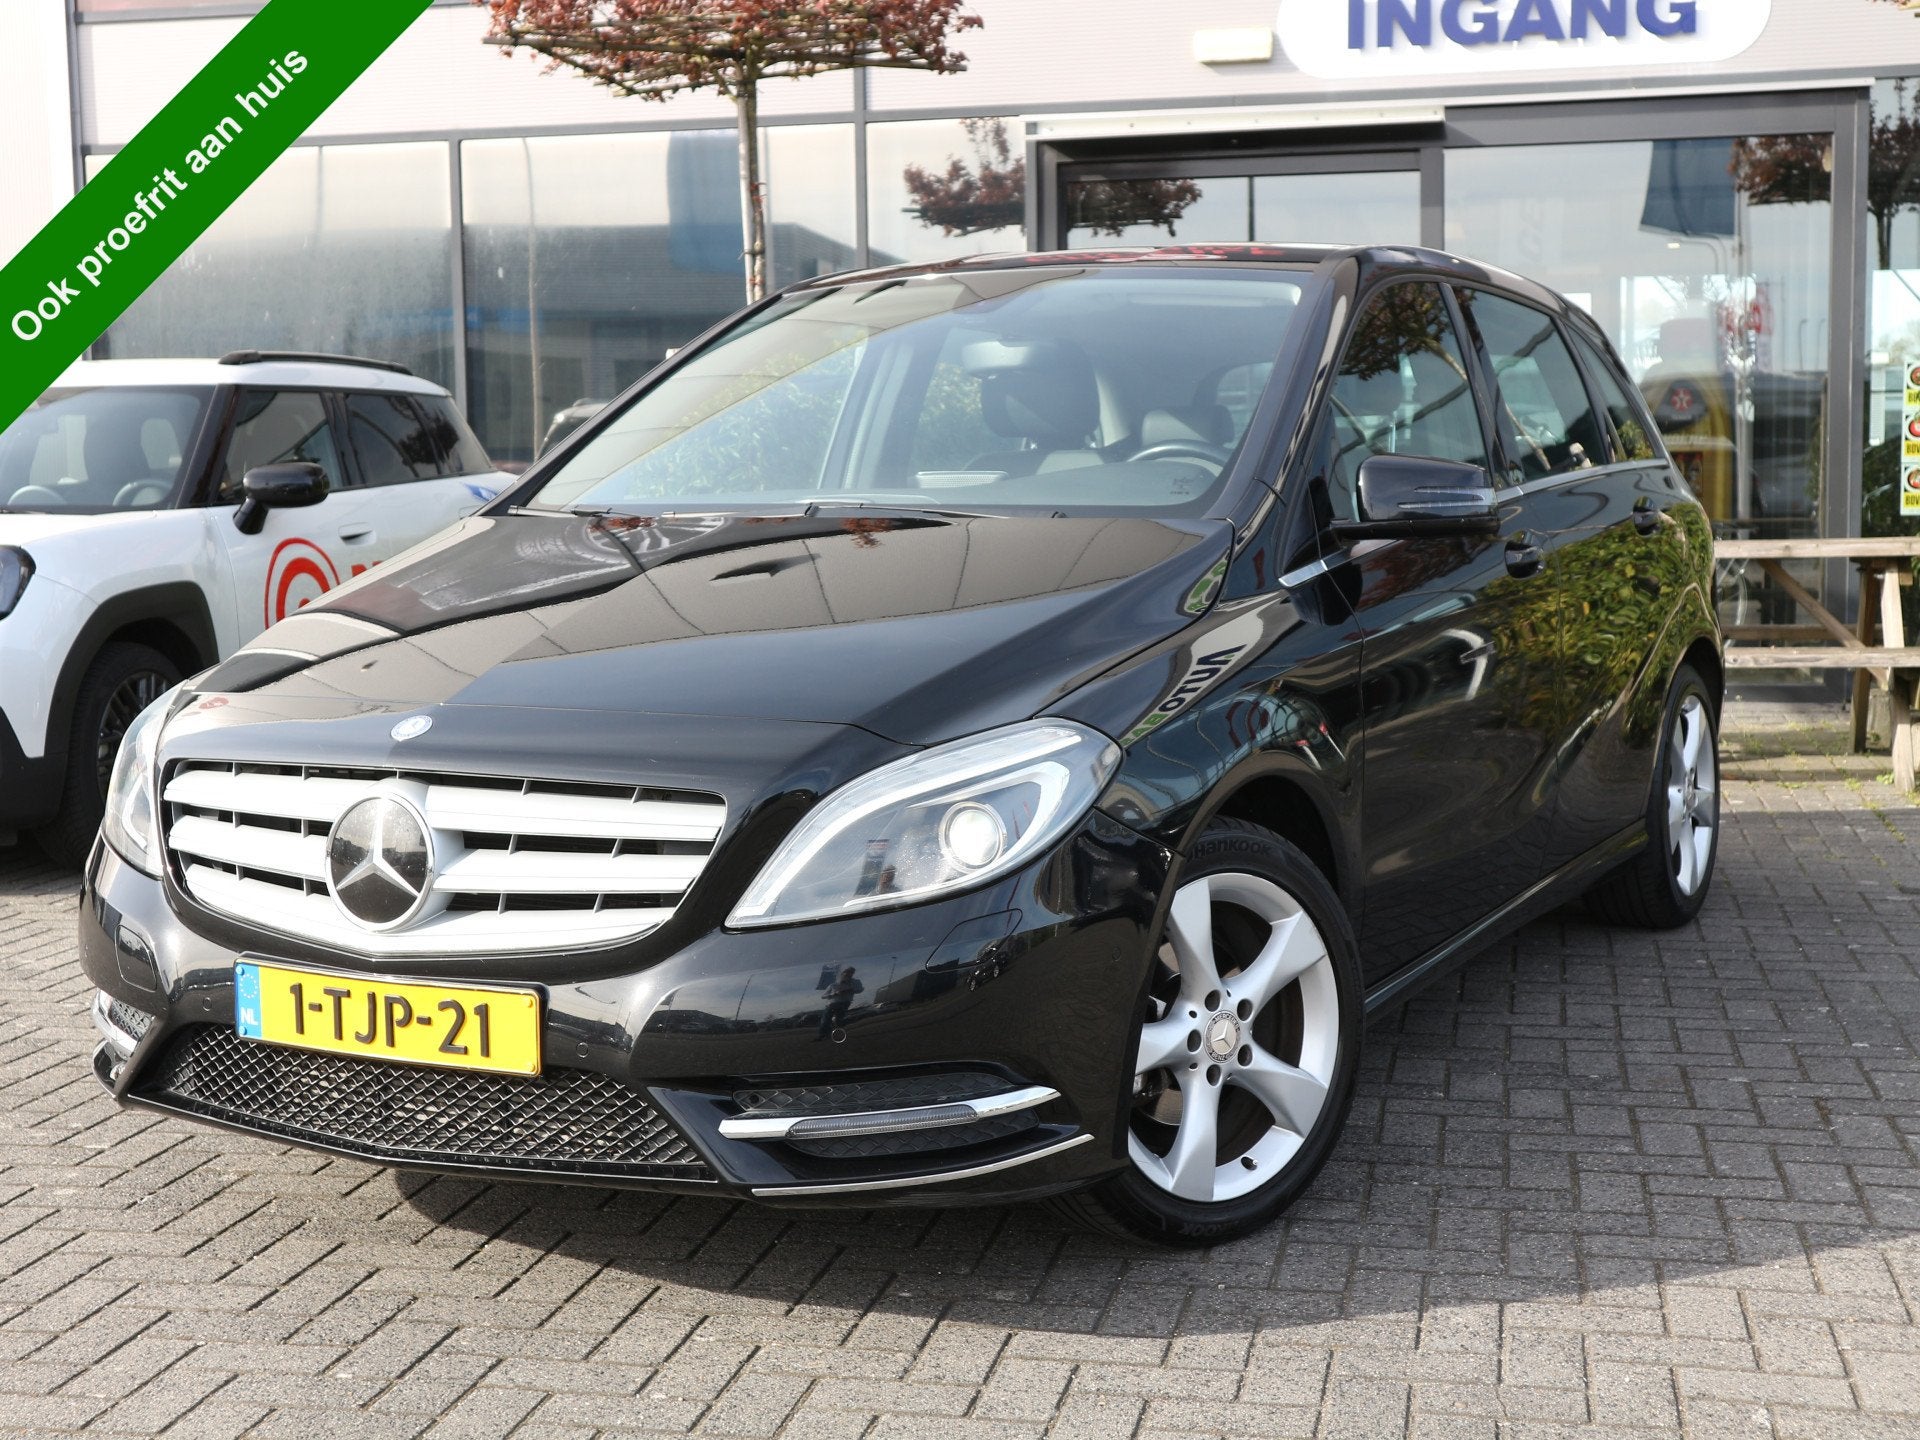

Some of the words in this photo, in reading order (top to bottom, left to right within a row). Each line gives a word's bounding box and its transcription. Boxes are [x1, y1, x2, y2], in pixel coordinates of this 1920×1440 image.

[1347, 0, 1697, 50] INGANG
[240, 1006, 259, 1026] NL
[290, 982, 492, 1058] 1-TJP-21
